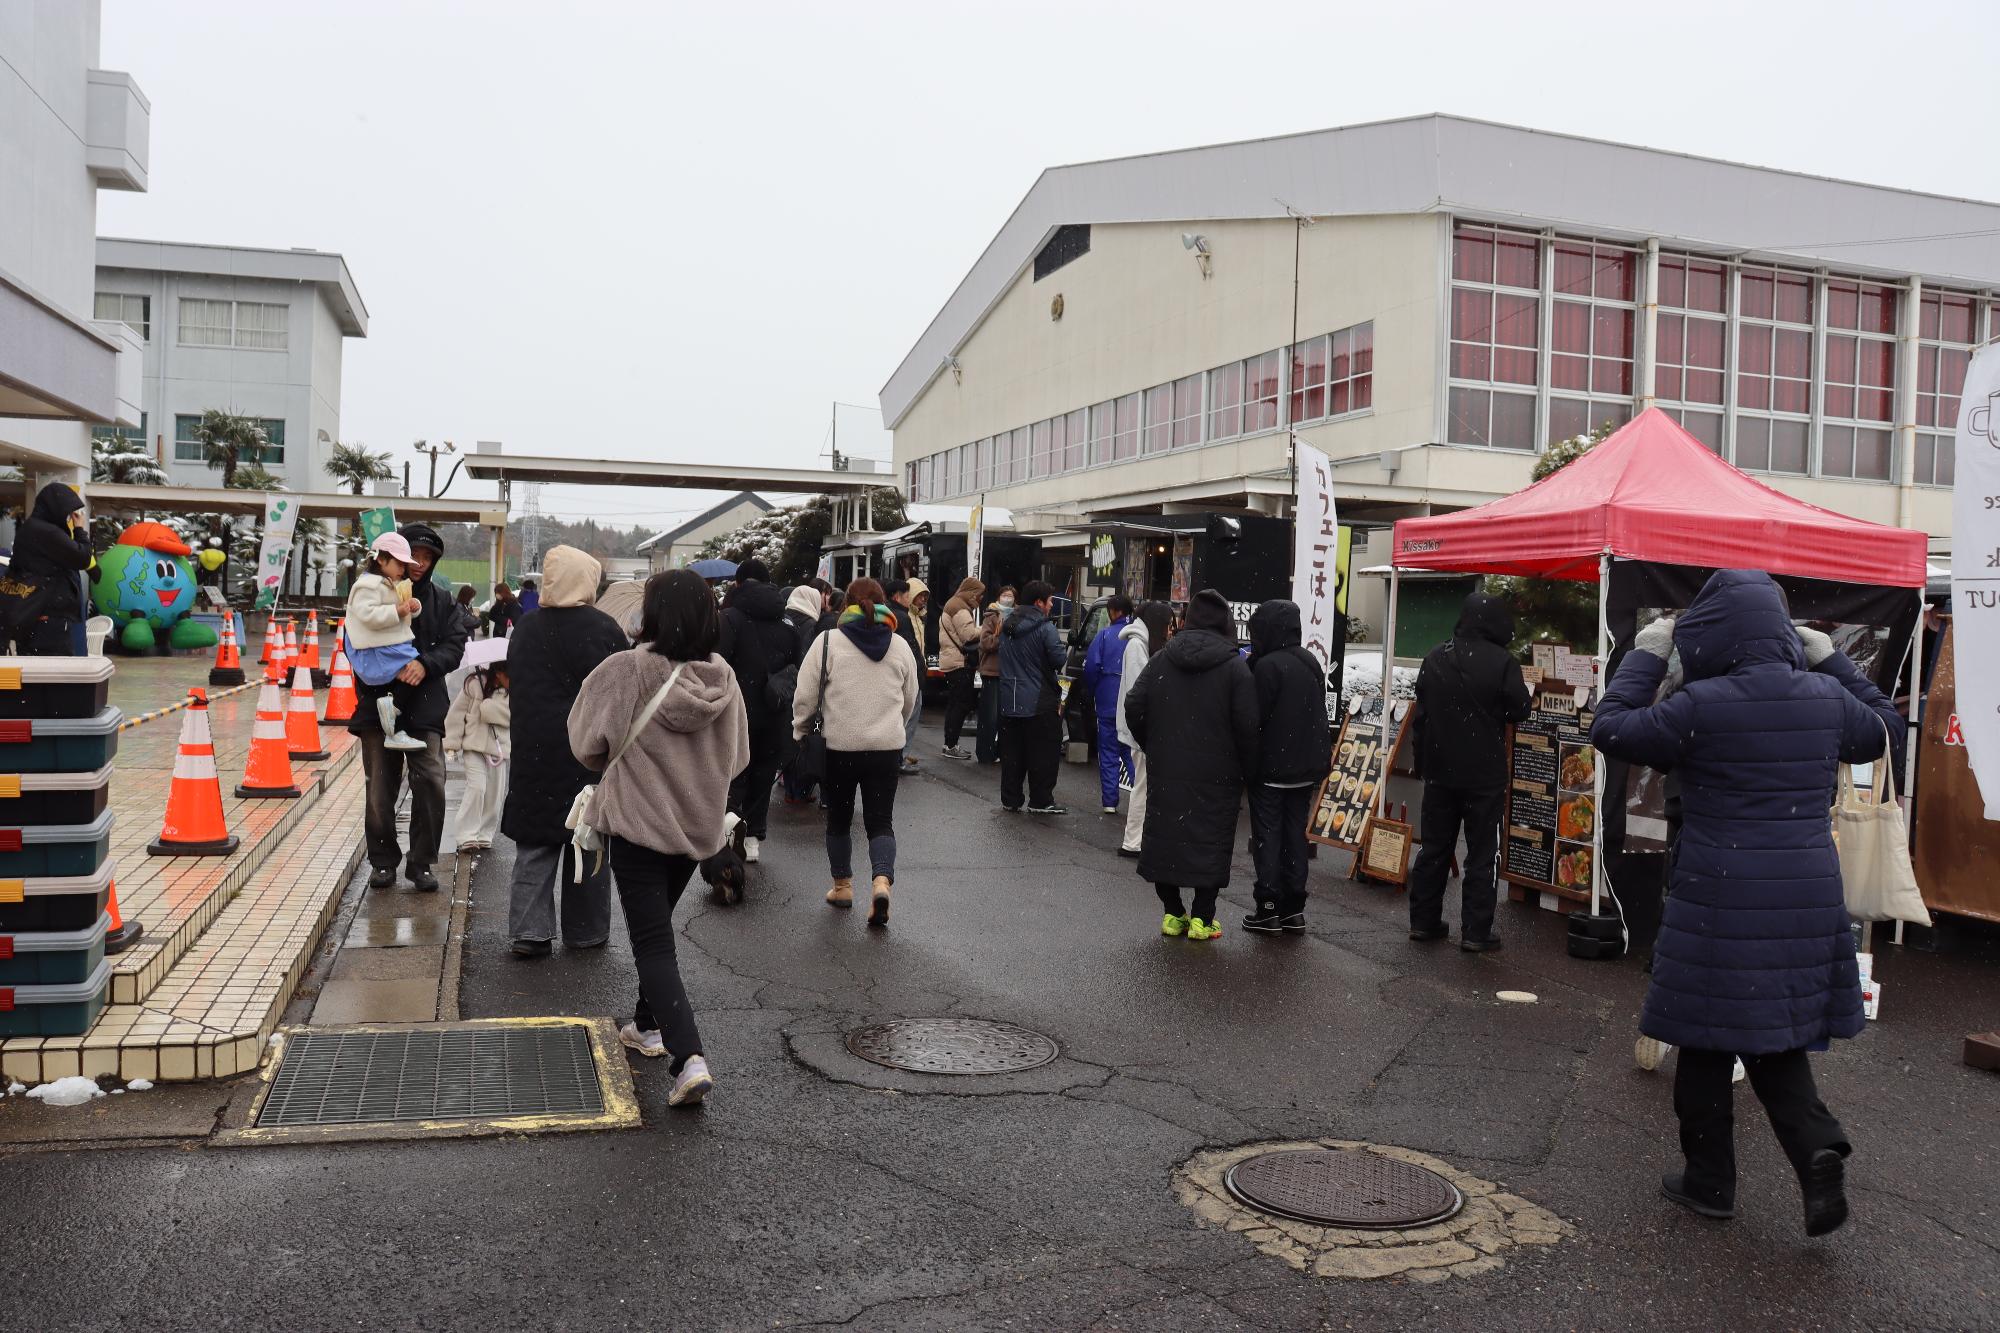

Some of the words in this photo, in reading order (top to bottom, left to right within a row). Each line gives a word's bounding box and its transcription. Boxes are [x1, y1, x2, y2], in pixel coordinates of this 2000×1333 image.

[1310, 461, 1335, 626] カフェごはん
[1543, 696, 1575, 712] MENU
[1364, 714, 1384, 726] DRIN
